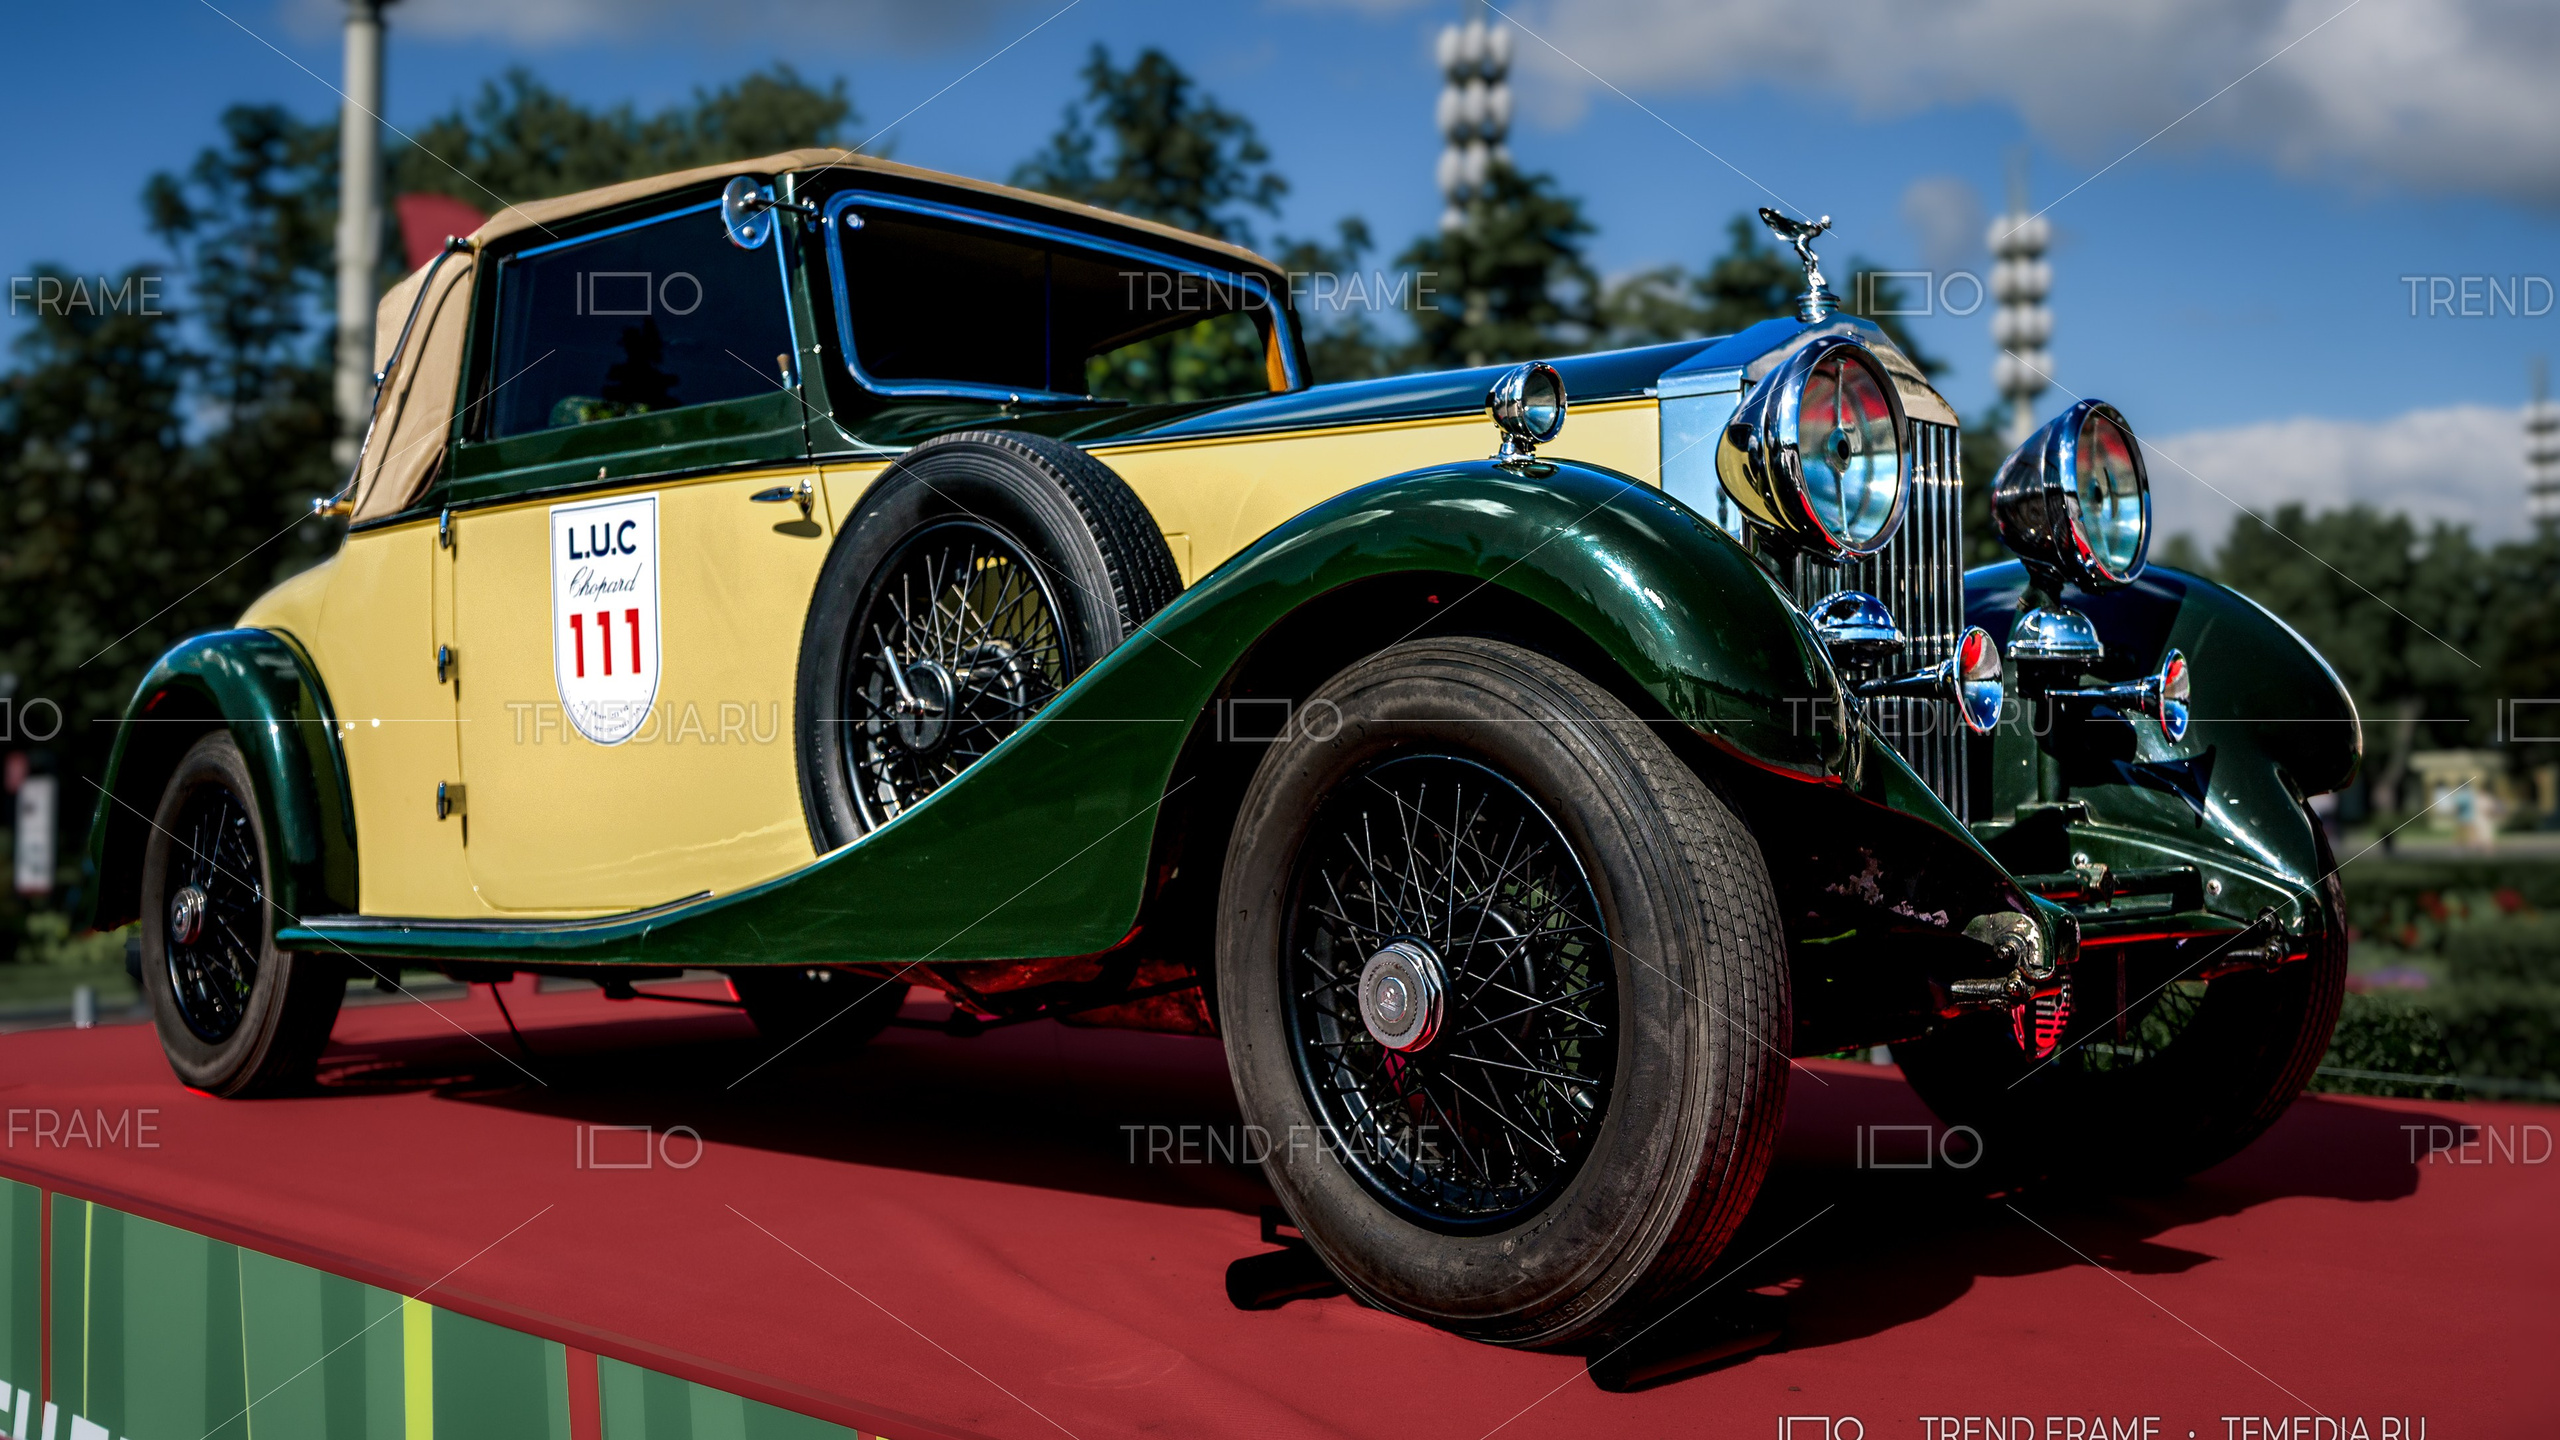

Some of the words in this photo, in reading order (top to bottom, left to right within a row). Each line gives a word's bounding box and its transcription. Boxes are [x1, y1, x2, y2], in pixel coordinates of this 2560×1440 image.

[568, 519, 637, 561] L.U.C
[566, 562, 643, 603] Chopard
[569, 607, 641, 678] 111
[1597, 1274, 1617, 1291] THE
[1535, 1292, 1595, 1329] LESTER
